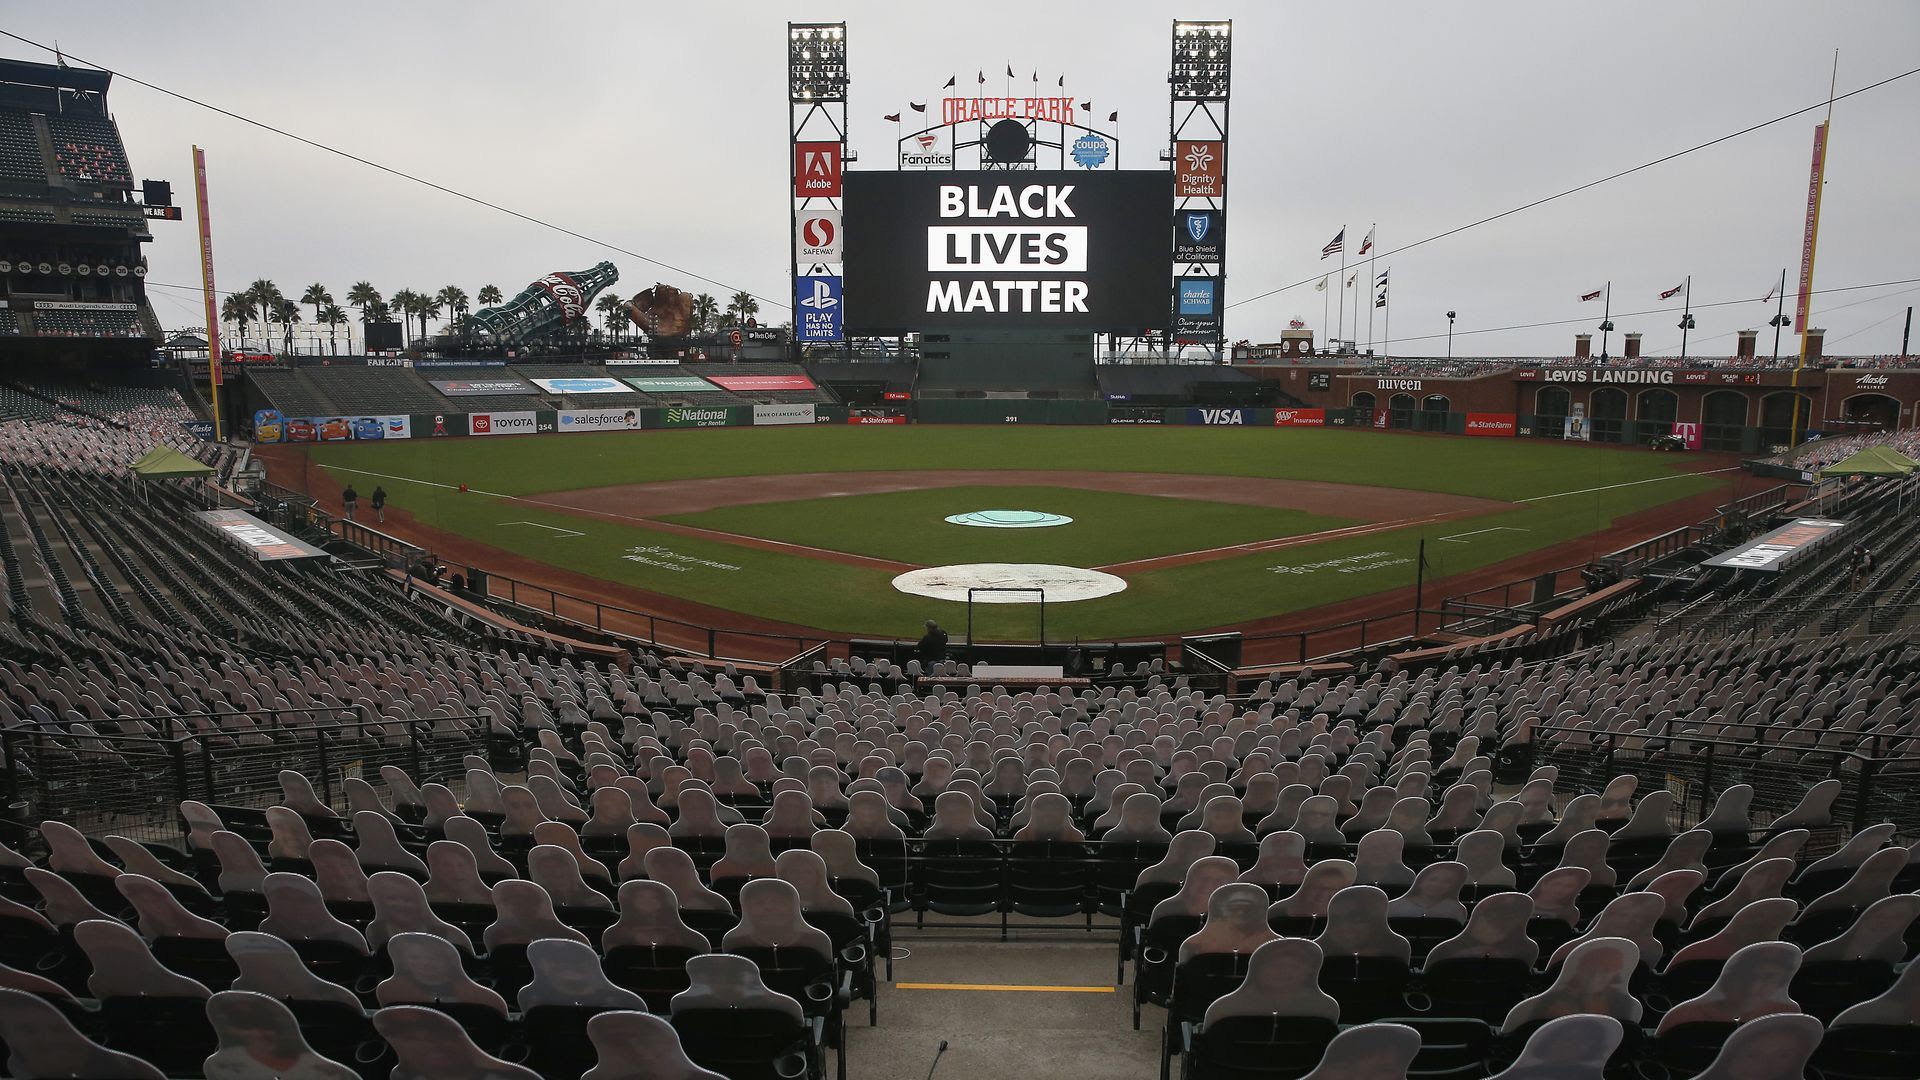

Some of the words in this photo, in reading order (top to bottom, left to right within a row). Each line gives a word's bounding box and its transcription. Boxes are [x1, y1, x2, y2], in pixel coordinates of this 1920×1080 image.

[942, 97, 1016, 126] ORACLE
[1024, 97, 1075, 126] PARK
[1076, 140, 1106, 152] coupa
[901, 153, 951, 165] Fanatics
[805, 179, 832, 189] Adobe
[1182, 174, 1216, 186] Dignity
[939, 185, 1077, 219] BLACK
[143, 208, 153, 216] WE
[154, 208, 165, 216] ARE
[946, 233, 1068, 265] LIVES
[1184, 252, 1219, 260] California
[926, 280, 1089, 313] MATTER
[1183, 290, 1210, 299] charles
[552, 284, 583, 319] Cola
[806, 313, 832, 322] PLAY
[1592, 370, 1674, 384] LANDING
[1856, 374, 1888, 384] Alaska
[1378, 378, 1422, 391] nuveen
[574, 413, 624, 426] salesforce
[681, 408, 728, 421] National
[1200, 409, 1243, 424] VISA
[494, 418, 534, 428] TOYOTA
